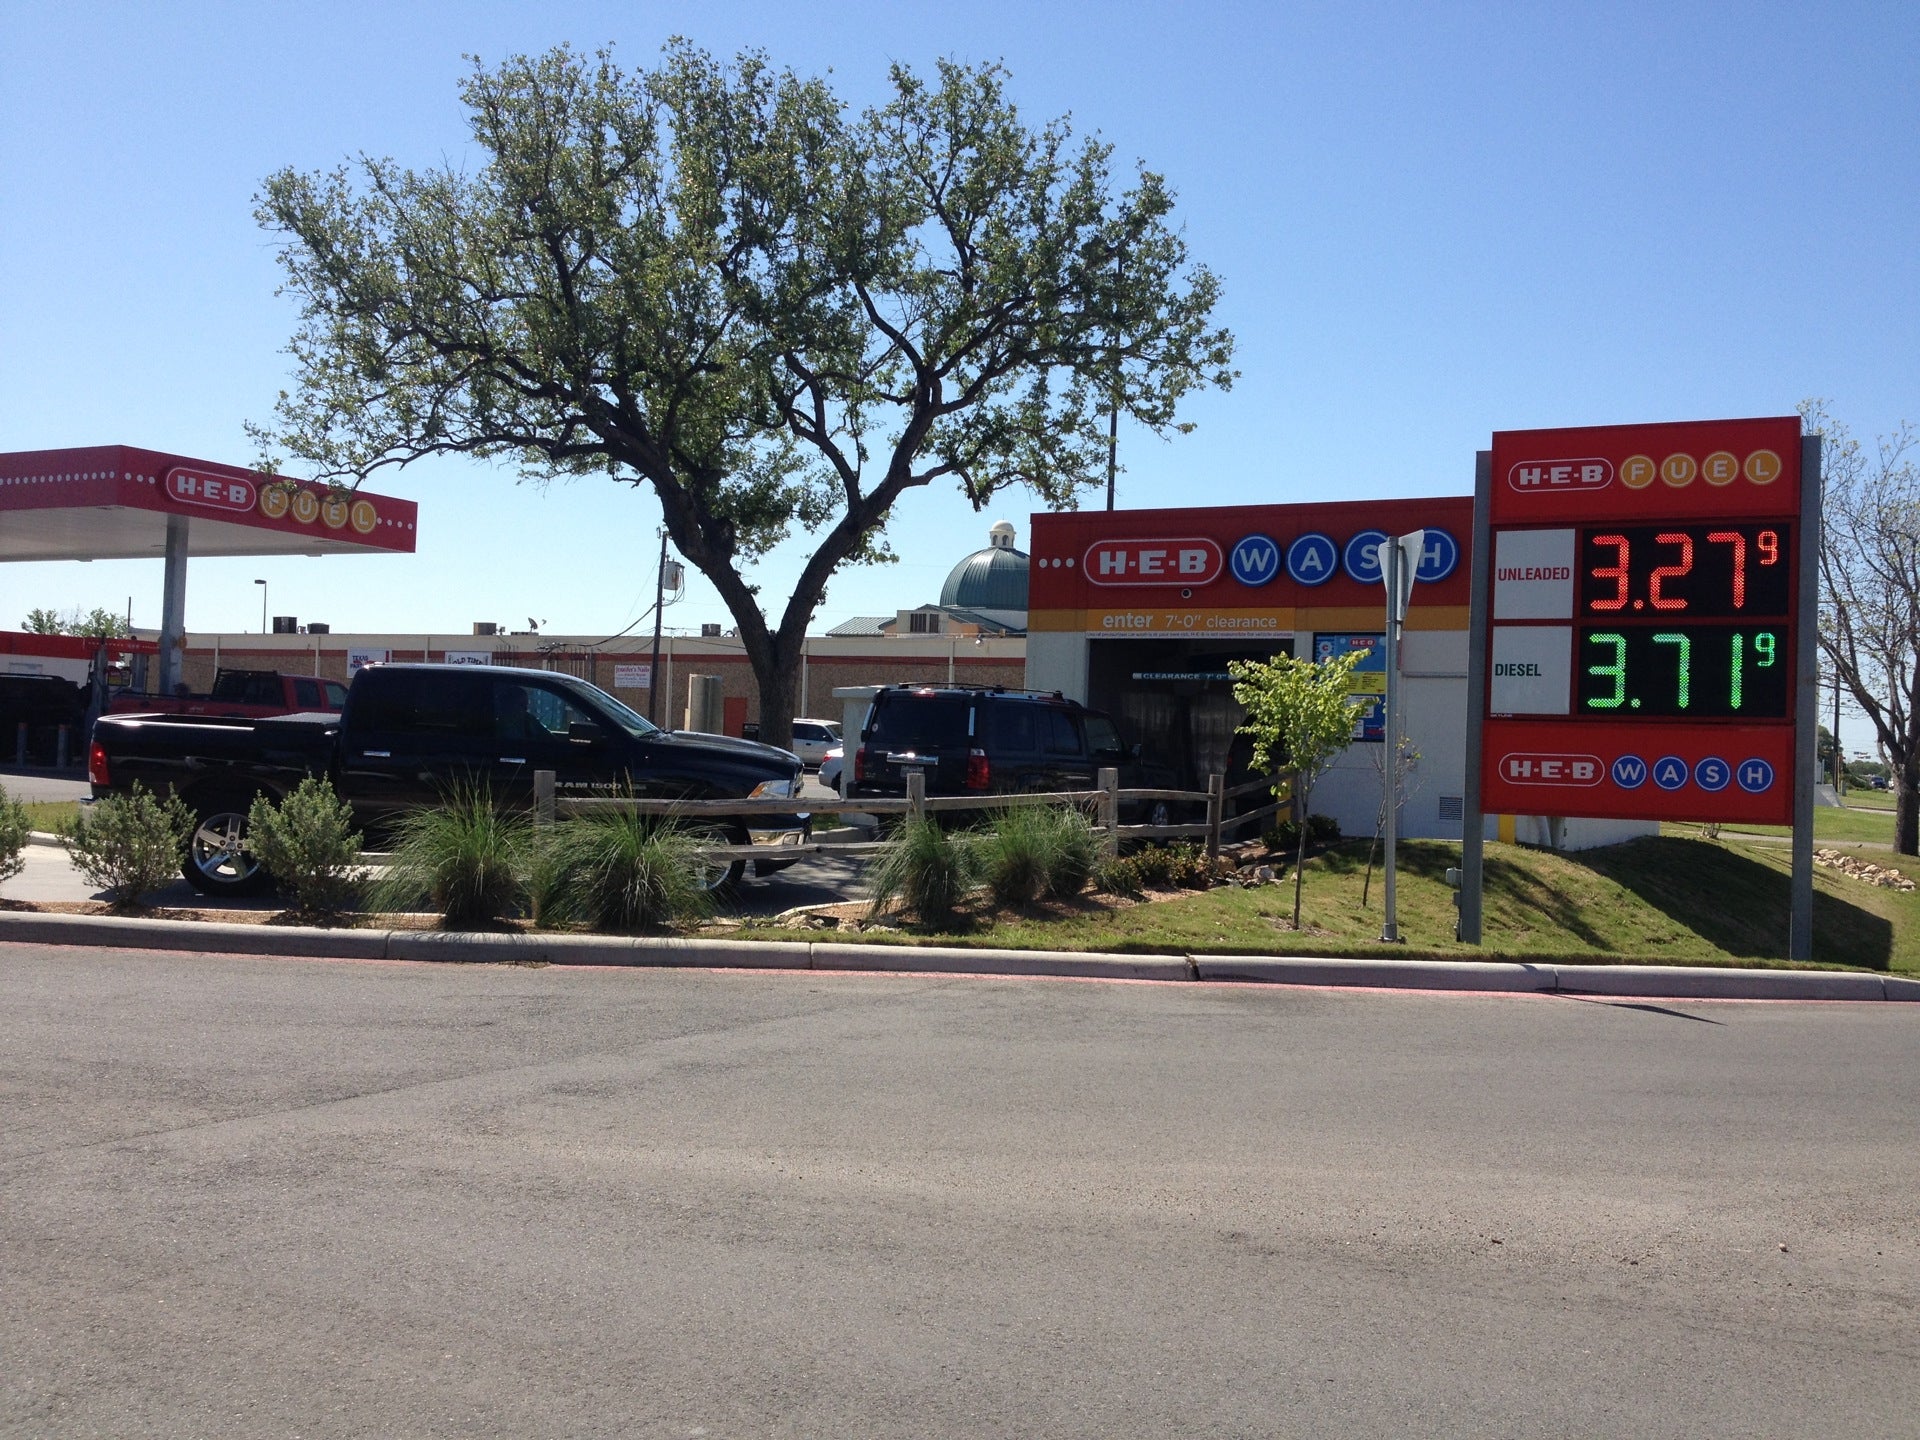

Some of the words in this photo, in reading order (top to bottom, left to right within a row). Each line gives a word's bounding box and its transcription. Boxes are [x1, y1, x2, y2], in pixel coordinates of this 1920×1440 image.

[1629, 458, 1771, 482] FUEL
[268, 492, 370, 527] FUEL
[1237, 542, 1442, 573] WASH
[1497, 567, 1571, 582] UNLEADED
[1102, 612, 1154, 628] enter
[1206, 614, 1278, 628] clearance
[1143, 672, 1201, 680] CLEARANCE
[1494, 663, 1542, 677] DIESEL
[1617, 762, 1764, 785] WASH
